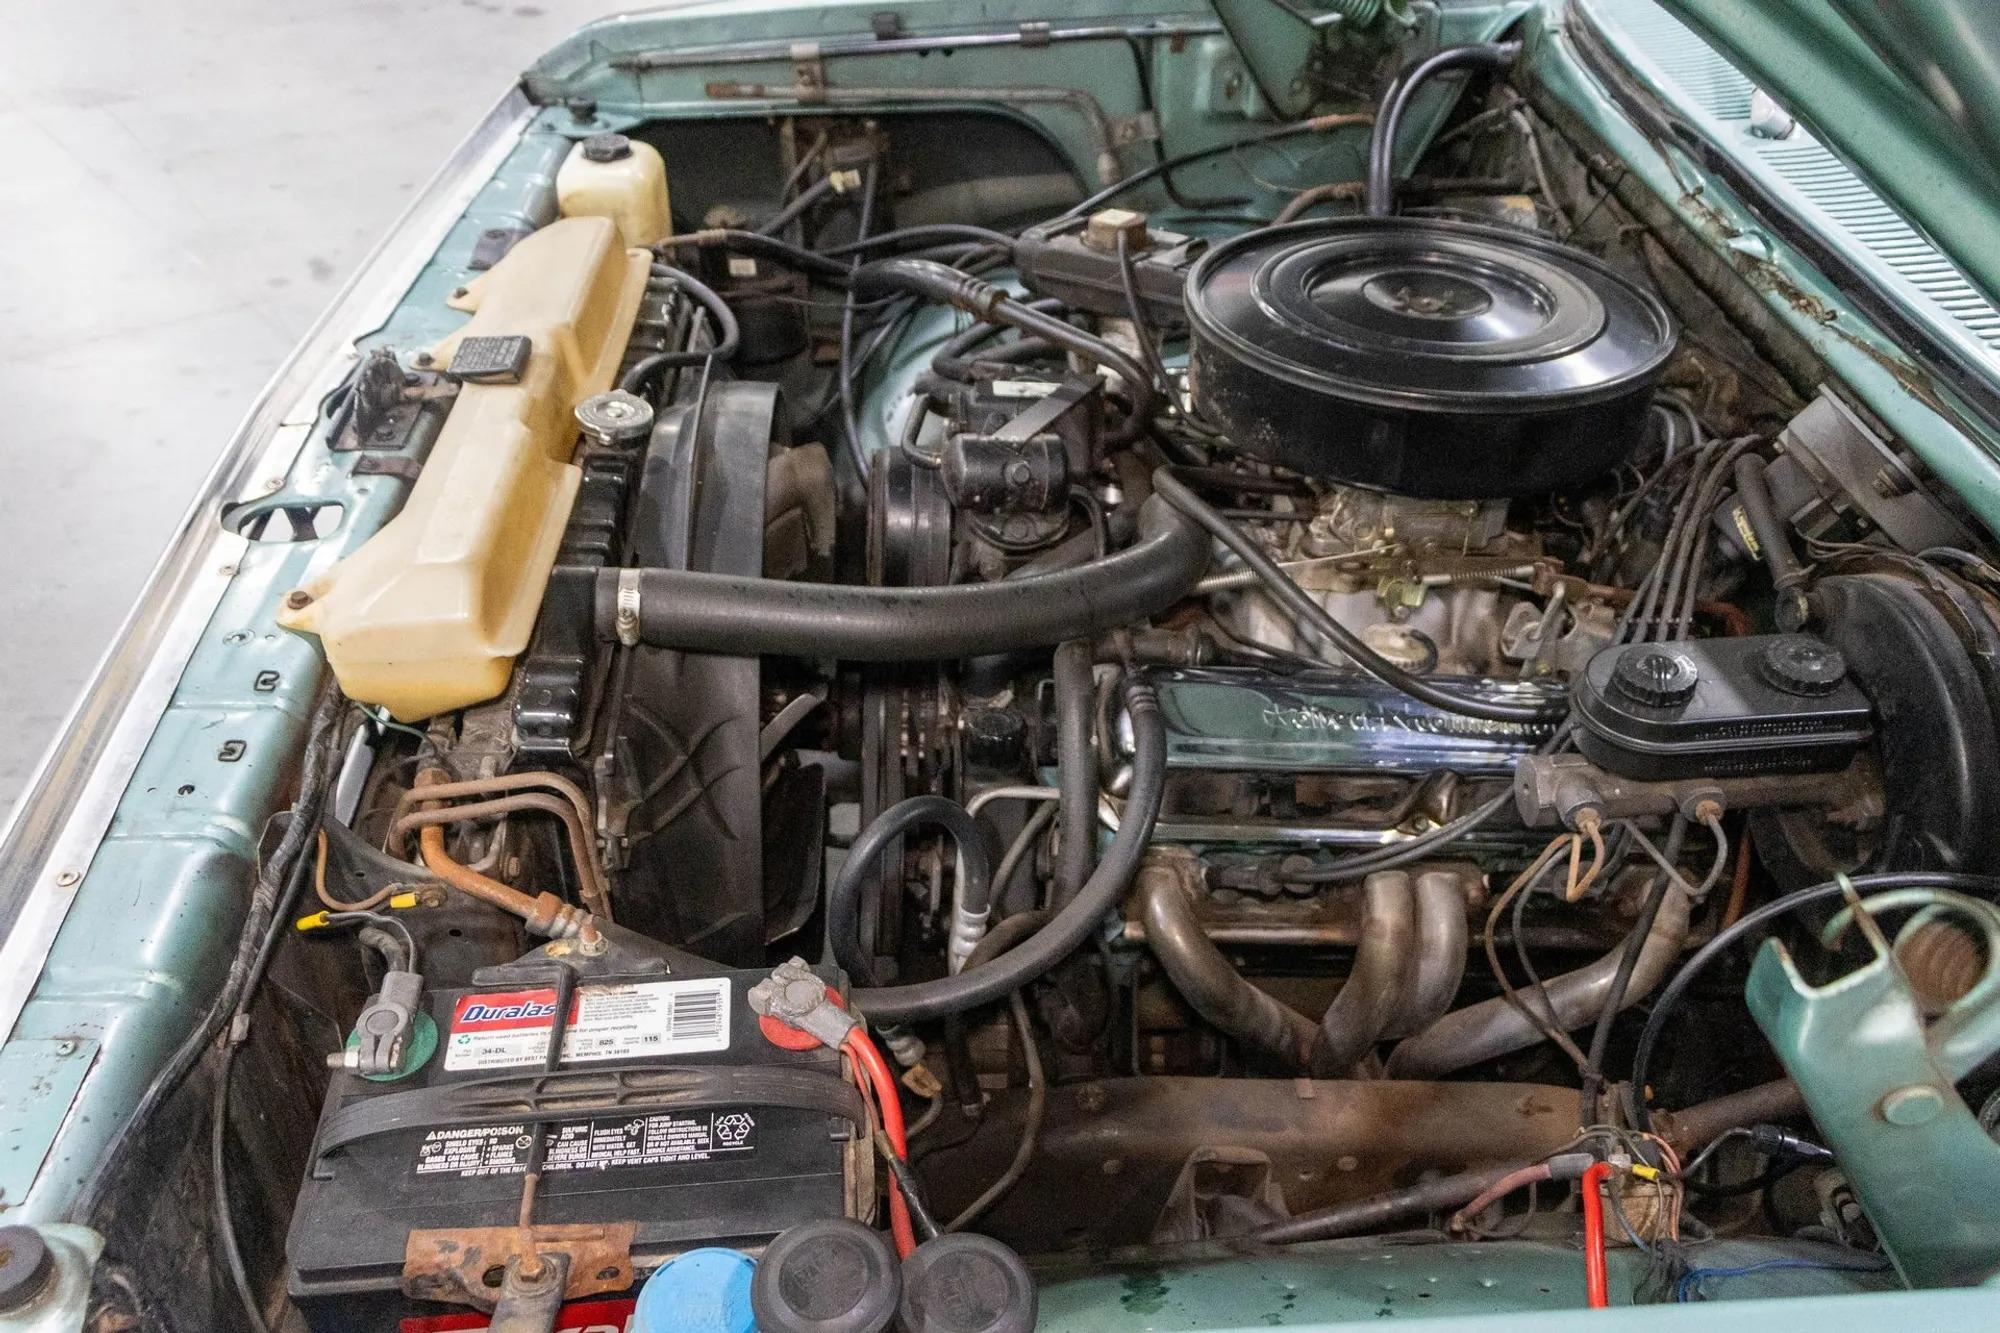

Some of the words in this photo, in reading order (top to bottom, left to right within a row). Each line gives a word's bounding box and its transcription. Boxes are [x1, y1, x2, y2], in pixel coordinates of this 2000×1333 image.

[460, 1001, 556, 1023] Duralas
[436, 1126, 524, 1140] DANGER/POISON
[445, 1139, 467, 1147] SHIELD
[593, 1135, 627, 1143] IMMEDIATELY
[444, 1146, 477, 1155] EXPLOSIVE
[425, 1155, 446, 1164] GASES
[416, 1162, 449, 1170] BLINDNESS
